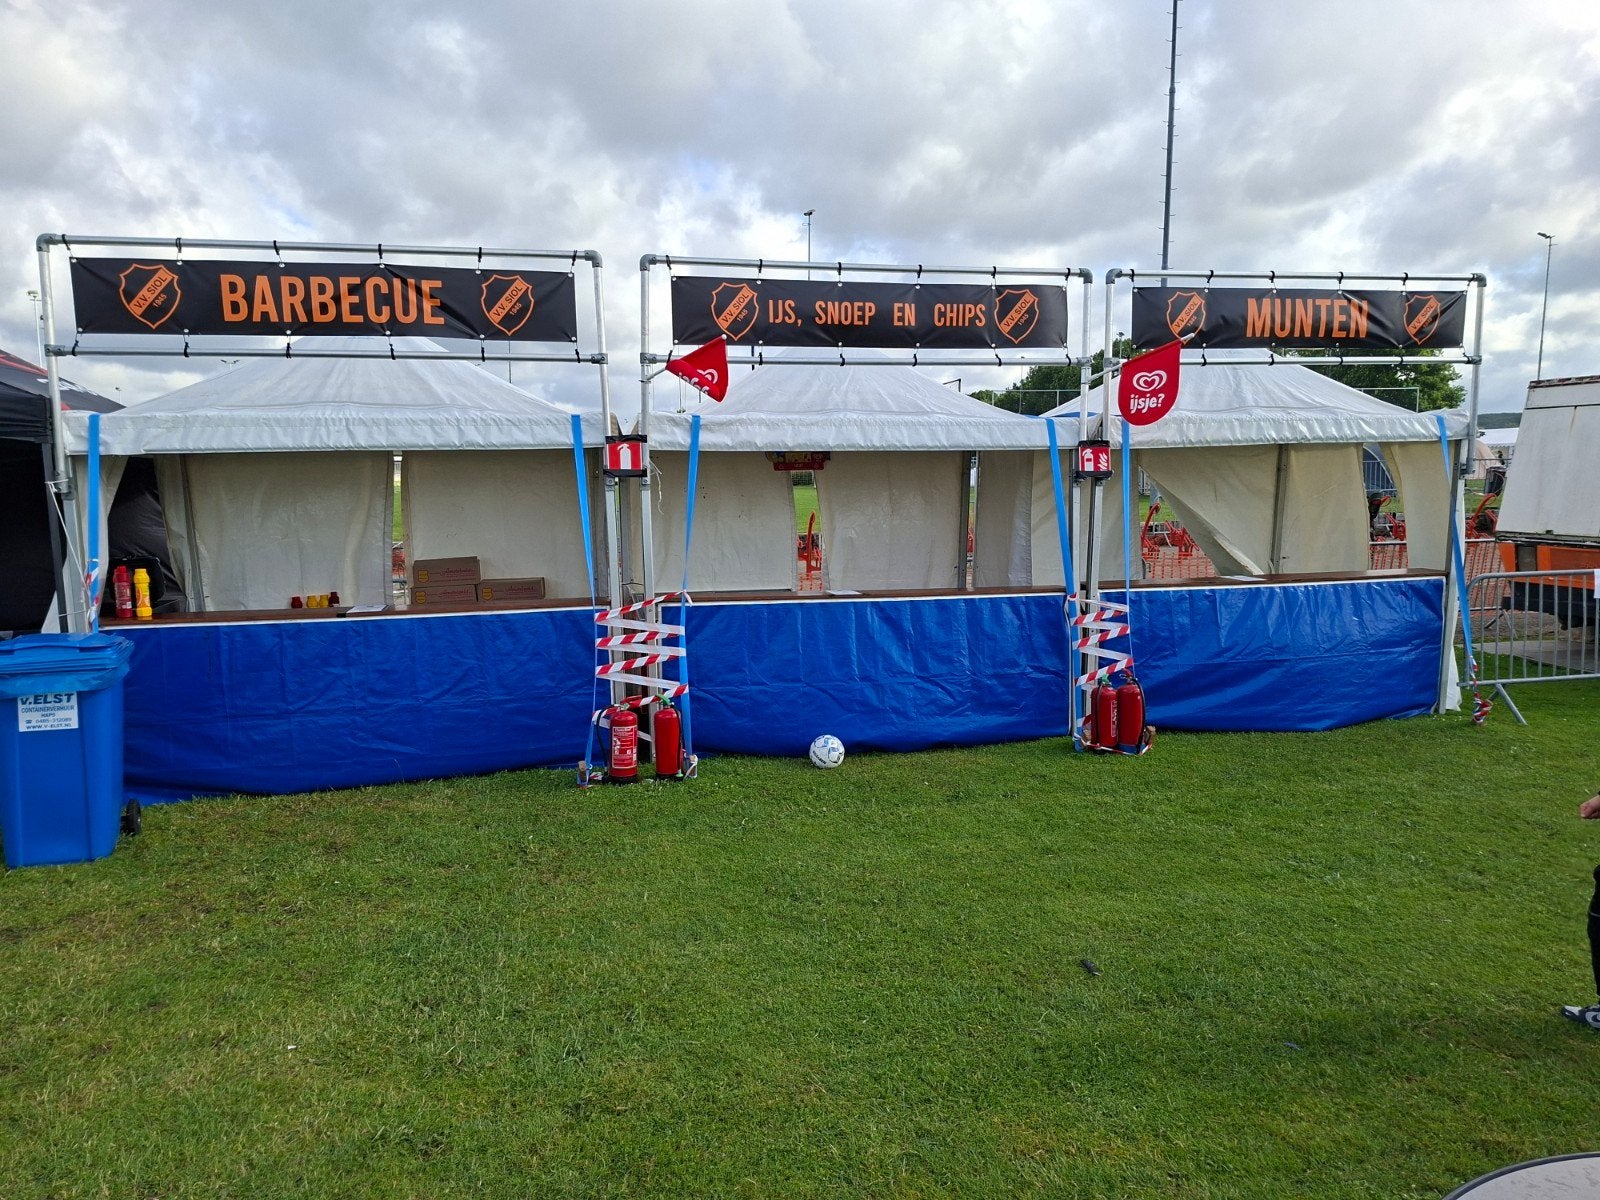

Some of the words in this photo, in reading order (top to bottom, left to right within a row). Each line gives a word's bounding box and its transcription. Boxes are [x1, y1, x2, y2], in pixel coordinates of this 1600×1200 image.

[133, 292, 150, 309] V.V.
[148, 275, 168, 295] SIOL
[152, 293, 168, 308] 1945
[220, 273, 445, 325] BARBECUE
[495, 302, 512, 319] V.V.
[509, 285, 530, 304] SIOL
[514, 302, 529, 316] 1945
[721, 309, 735, 323] V.V.
[733, 293, 750, 310] SIOL
[736, 308, 749, 322] 1945
[768, 299, 802, 327] IJS,
[815, 300, 876, 326] SNOEP
[893, 302, 916, 326] EN
[933, 303, 986, 327] CHIPS
[1003, 314, 1016, 328] V.V.
[1014, 298, 1031, 315] SIOL
[1017, 313, 1029, 326] 1945
[1184, 301, 1199, 317] SIOL
[1246, 298, 1368, 338] MUNTEN
[1419, 304, 1434, 319] SIOL
[1130, 393, 1165, 414] ijsje?
